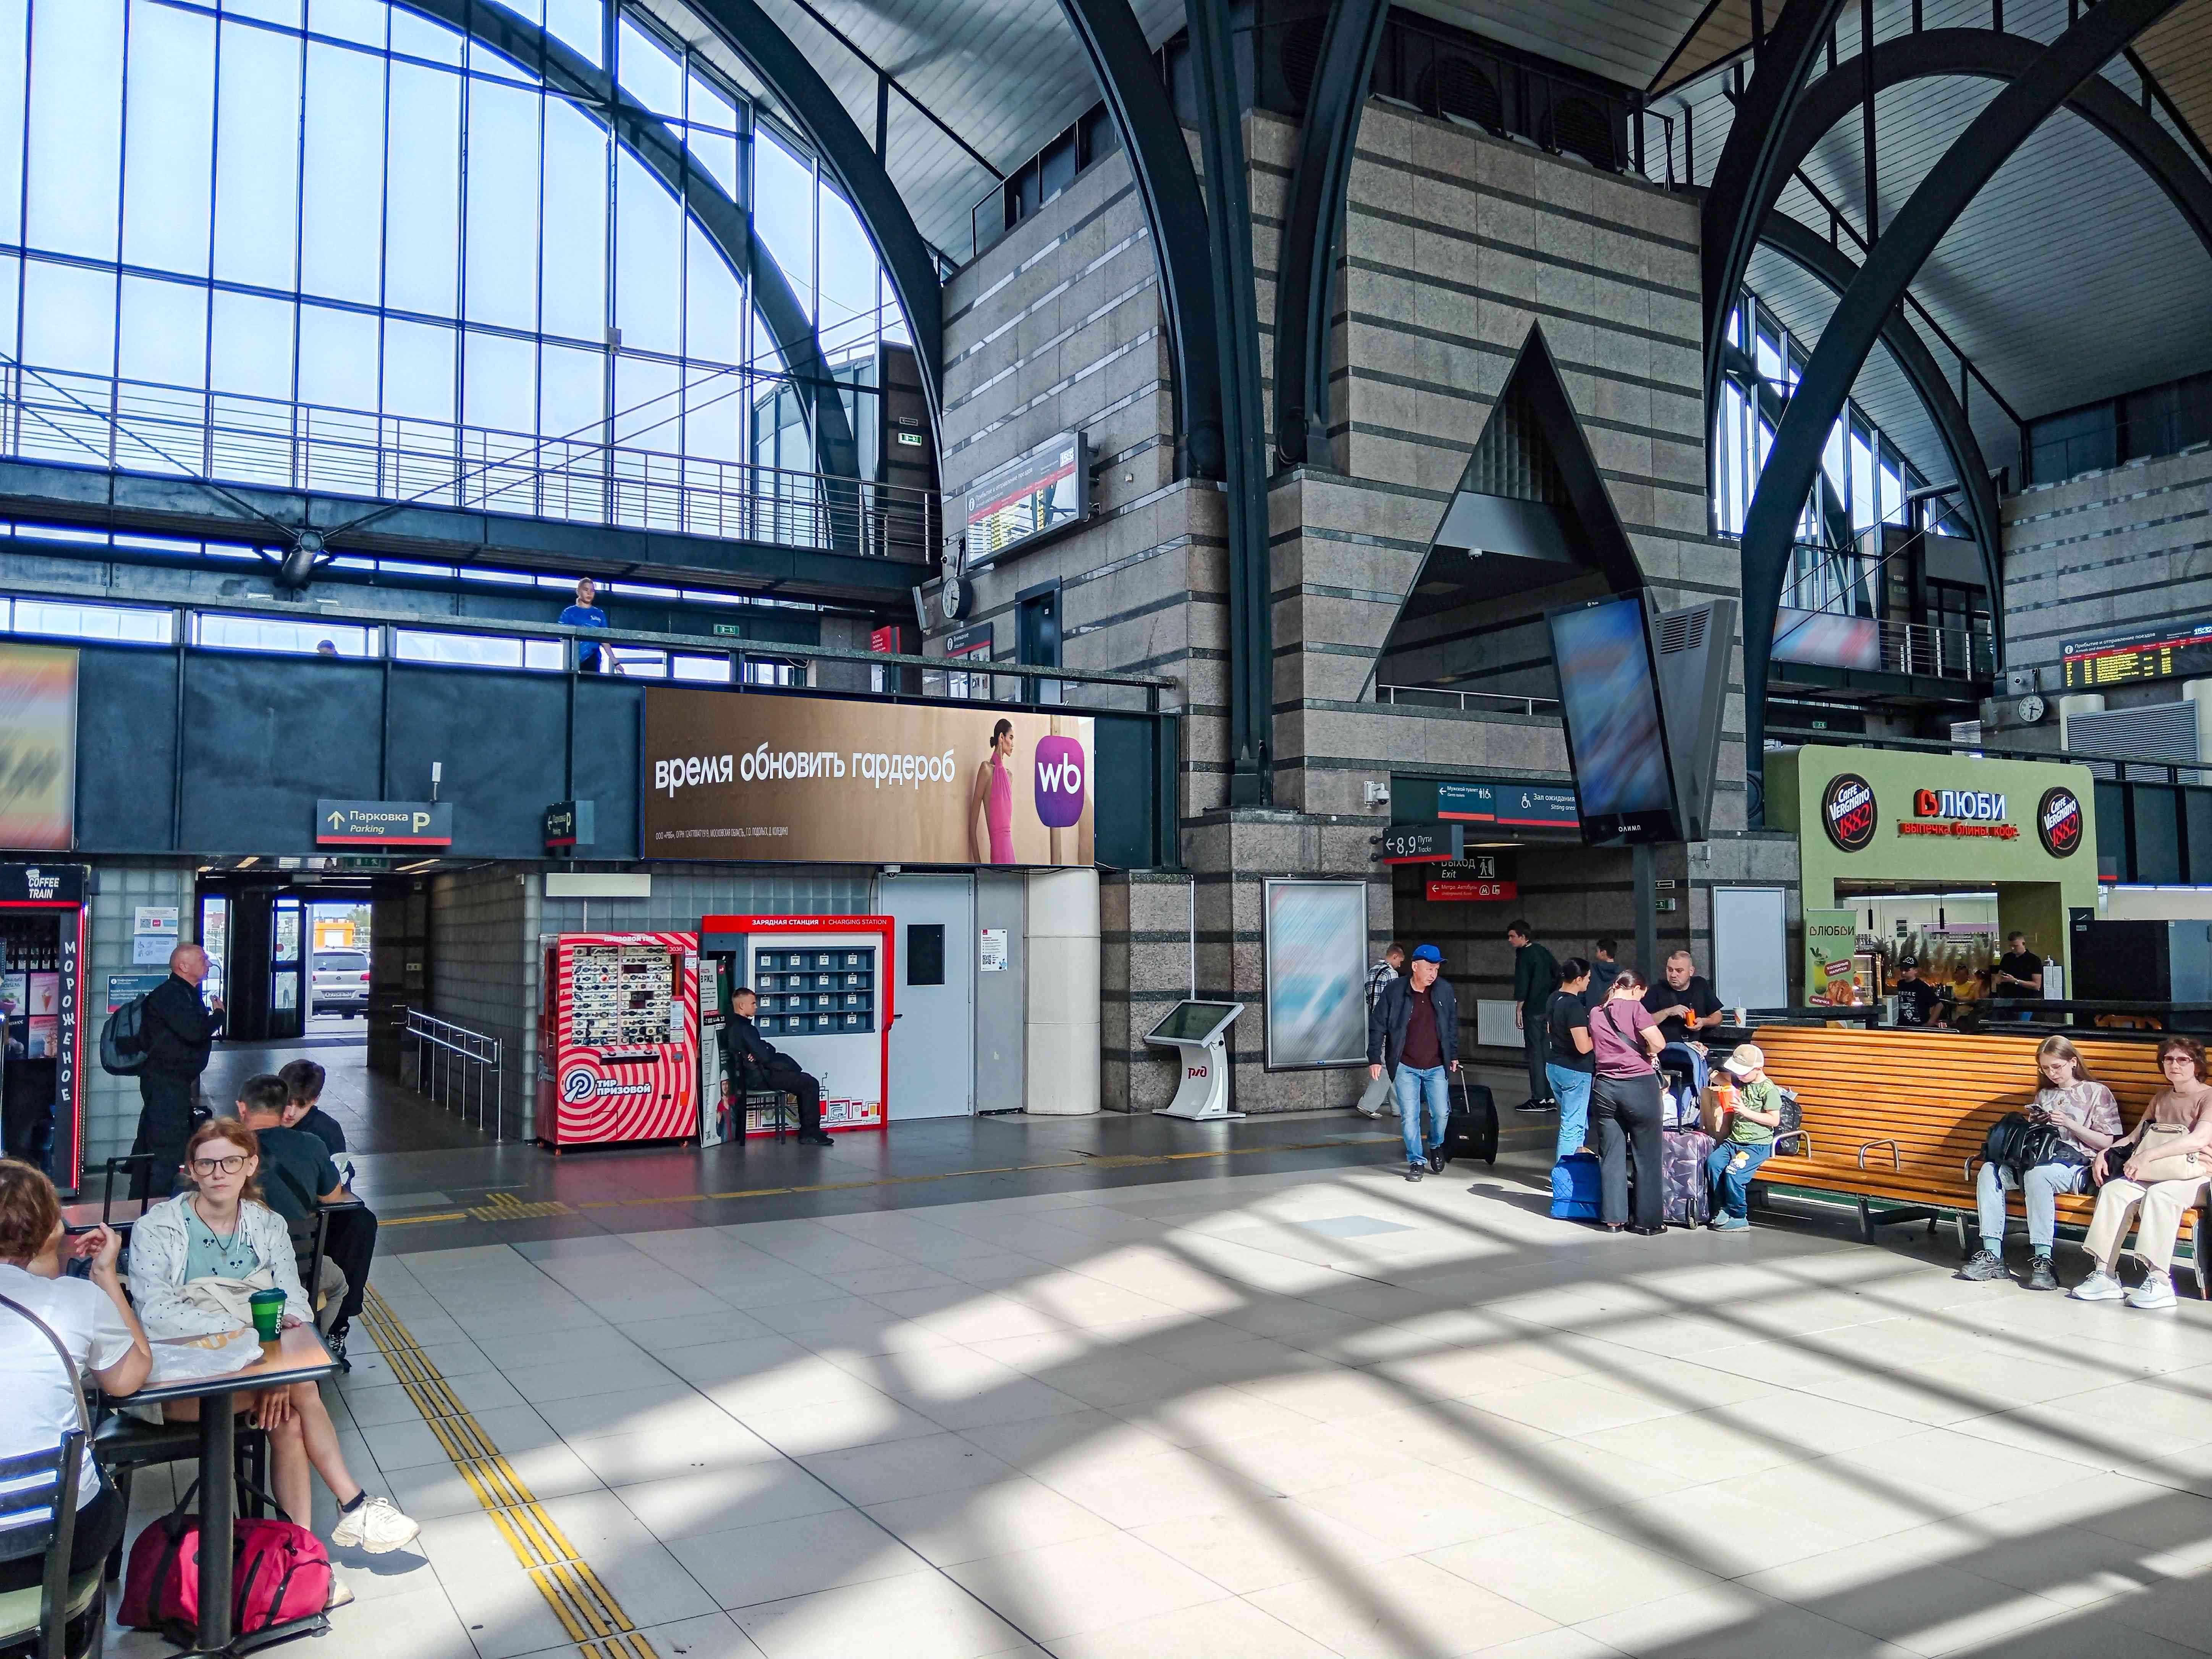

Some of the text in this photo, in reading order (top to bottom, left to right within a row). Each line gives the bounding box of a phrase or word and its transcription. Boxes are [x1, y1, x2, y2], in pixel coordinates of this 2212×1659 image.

[2194, 626, 2212, 635] 15:32
[656, 741, 955, 797] время обновить гардероб
[1038, 752, 1081, 794] wb
[1545, 794, 1575, 803] ожидания
[350, 811, 409, 823] Парковка
[1840, 803, 1870, 839] 1882
[350, 825, 385, 834] Parking
[676, 830, 685, 838] ОГРН
[710, 828, 731, 837] МОСКОВСКАЯ
[772, 826, 788, 836] КОЛЕДИНО
[2053, 813, 2077, 847] 1882
[1396, 836, 1432, 856] 8,9 Пути
[1442, 869, 1456, 878] Exit
[28, 878, 60, 888] COFFEE
[29, 888, 53, 899] TRAIN
[61, 941, 76, 1101] МОРОЖЕНОЕ
[597, 1083, 651, 1096] ПРИЗОВОЙ
